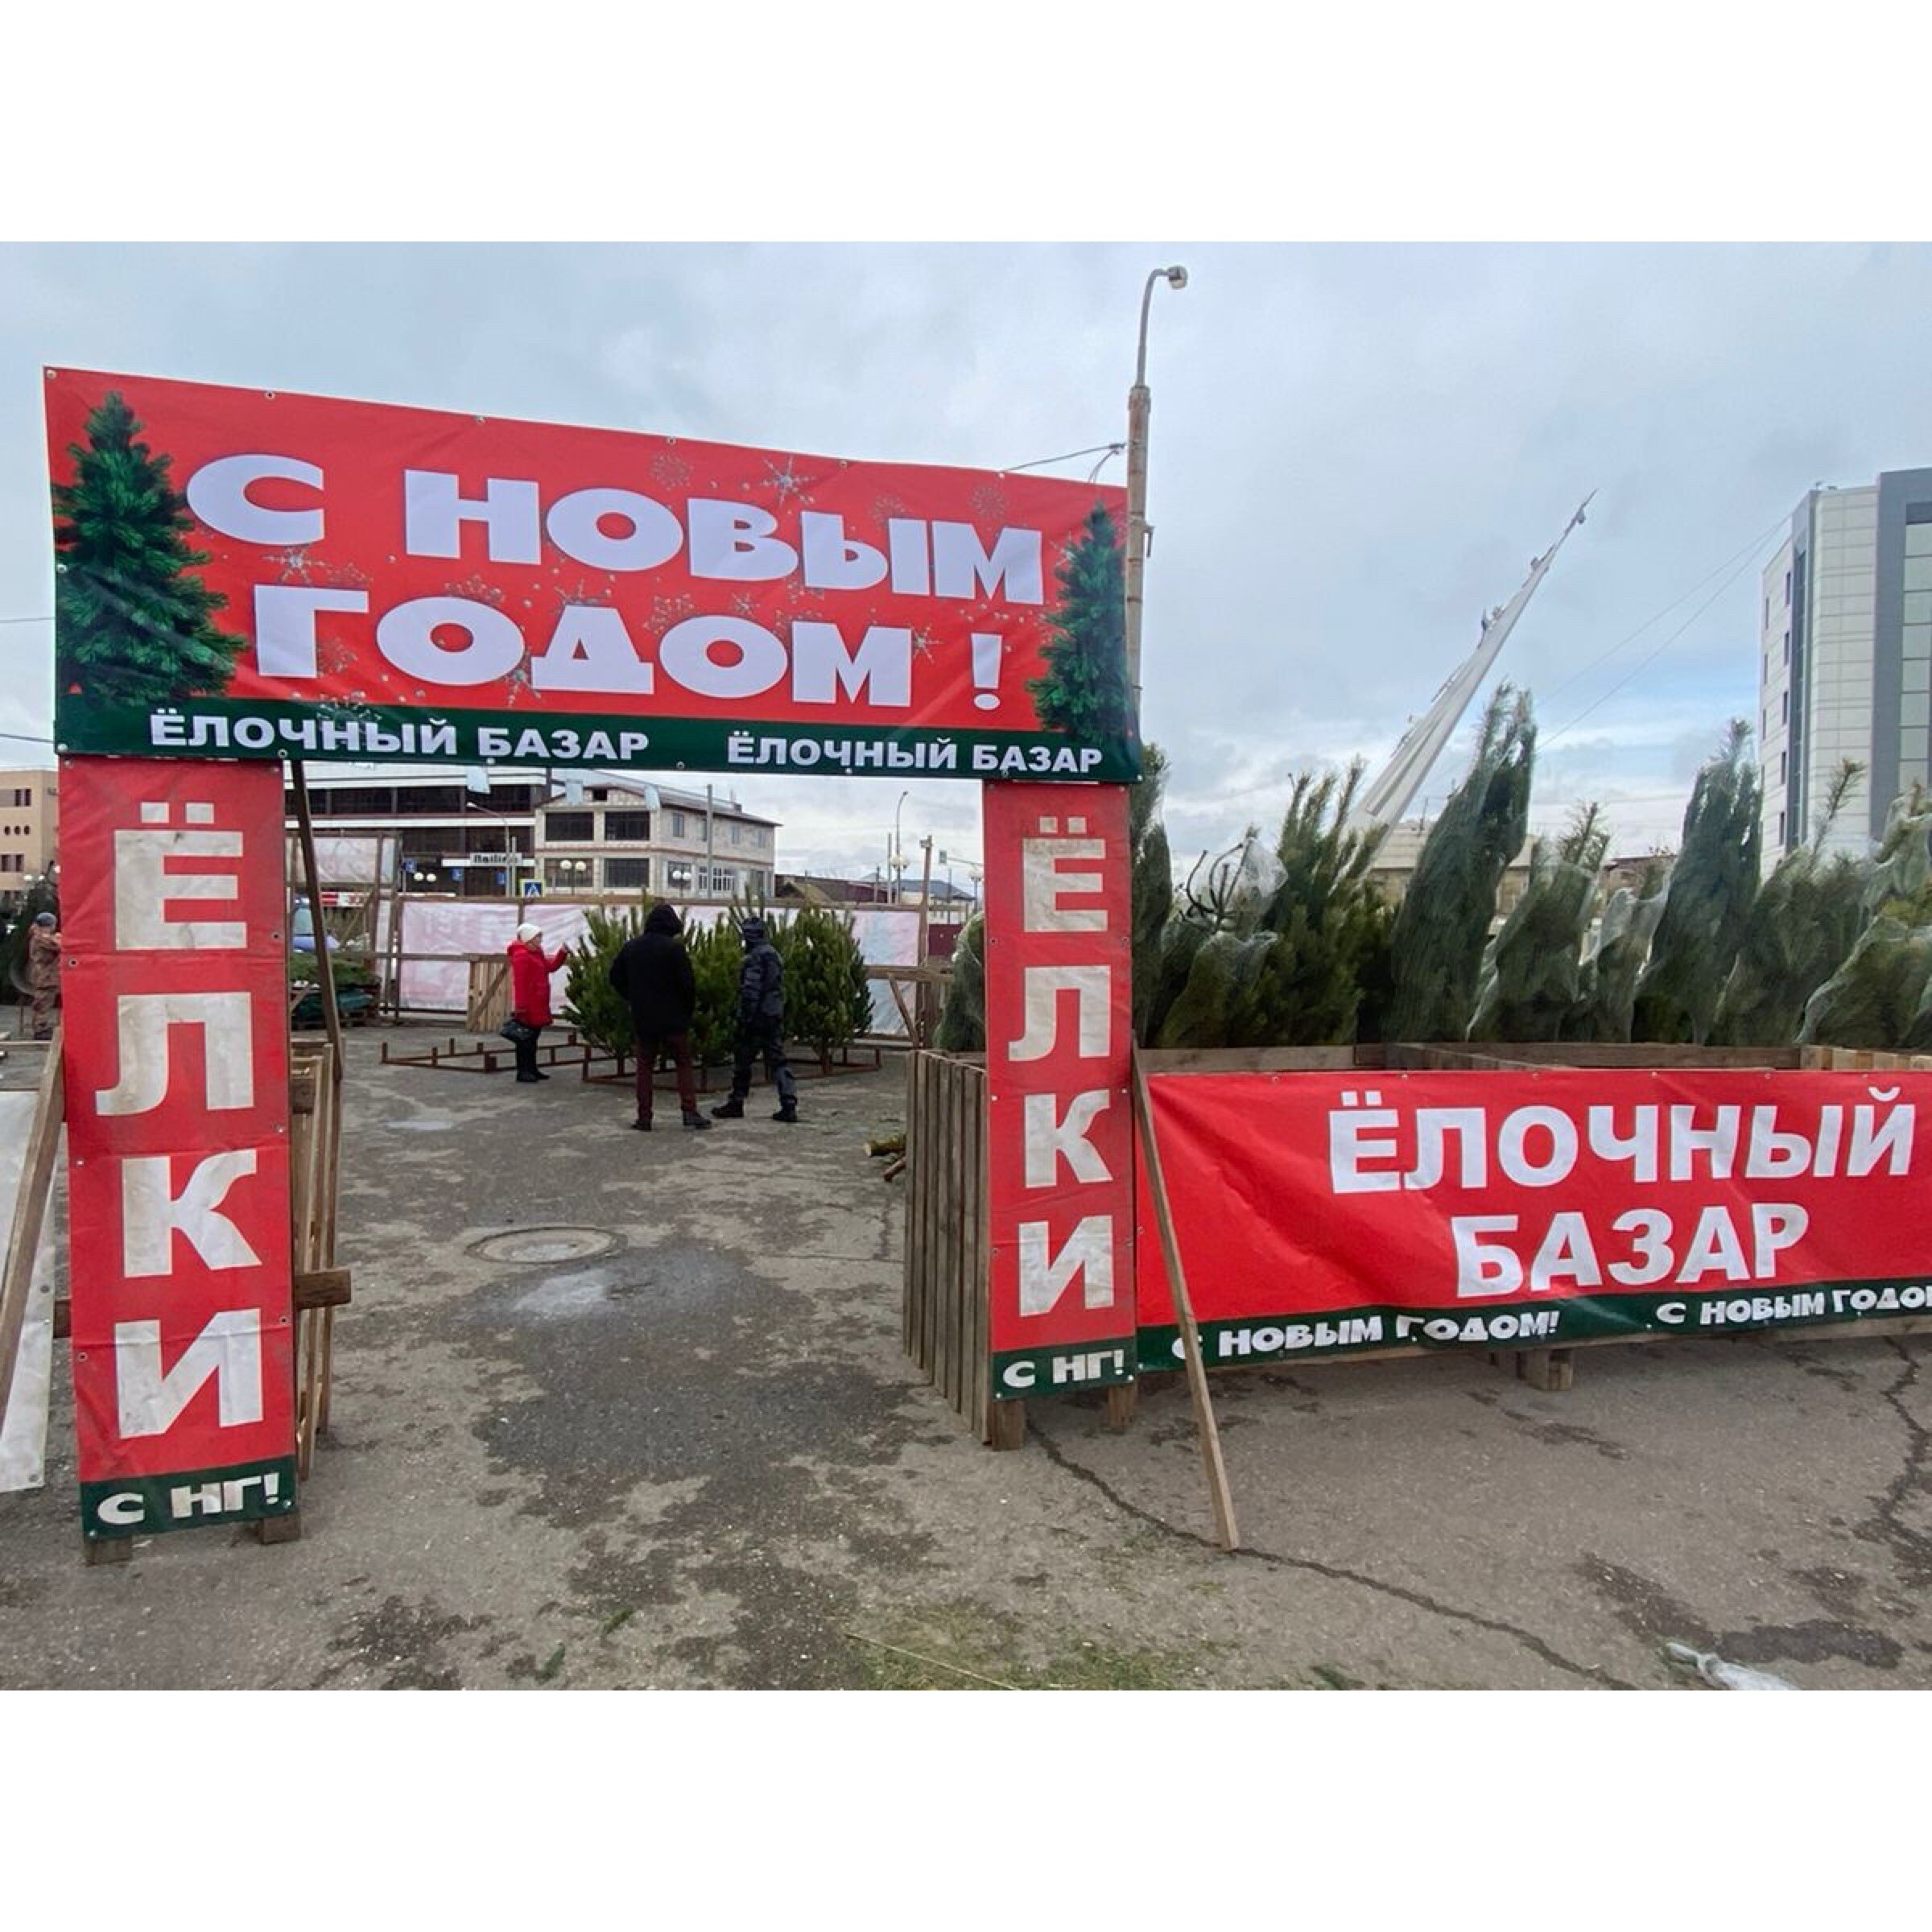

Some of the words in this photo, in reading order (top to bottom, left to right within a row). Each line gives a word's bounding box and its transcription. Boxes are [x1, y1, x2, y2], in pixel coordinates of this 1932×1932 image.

[186, 453, 325, 545] С
[405, 470, 1043, 605] НОВЫМ
[255, 584, 912, 708] ГОДОМ
[970, 634, 1002, 711] !
[151, 708, 458, 755] ЁЛОЧНЫЙ
[477, 727, 649, 761] БАЗАР
[728, 729, 957, 770] ЁЛОЧНЫЙ
[972, 744, 1103, 774] БАЗАР
[1008, 816, 1114, 1318] ЁЛКИ
[95, 802, 264, 1439] ЁЛКИ
[1327, 1086, 1916, 1195] ЁЛОЧНЫЙ
[1449, 1203, 1809, 1298] БАЗАР
[1219, 1315, 1384, 1357] НОВЫМ
[1396, 1311, 1559, 1343] ГОДОМ!
[1657, 1302, 1686, 1323] С
[1699, 1292, 1825, 1325] НОВЫМ
[1832, 1286, 1932, 1313] ГОДО
[1003, 1361, 1035, 1389] С
[1052, 1350, 1124, 1383] НГ!
[97, 1493, 145, 1525] С
[171, 1472, 279, 1519] НГ!
